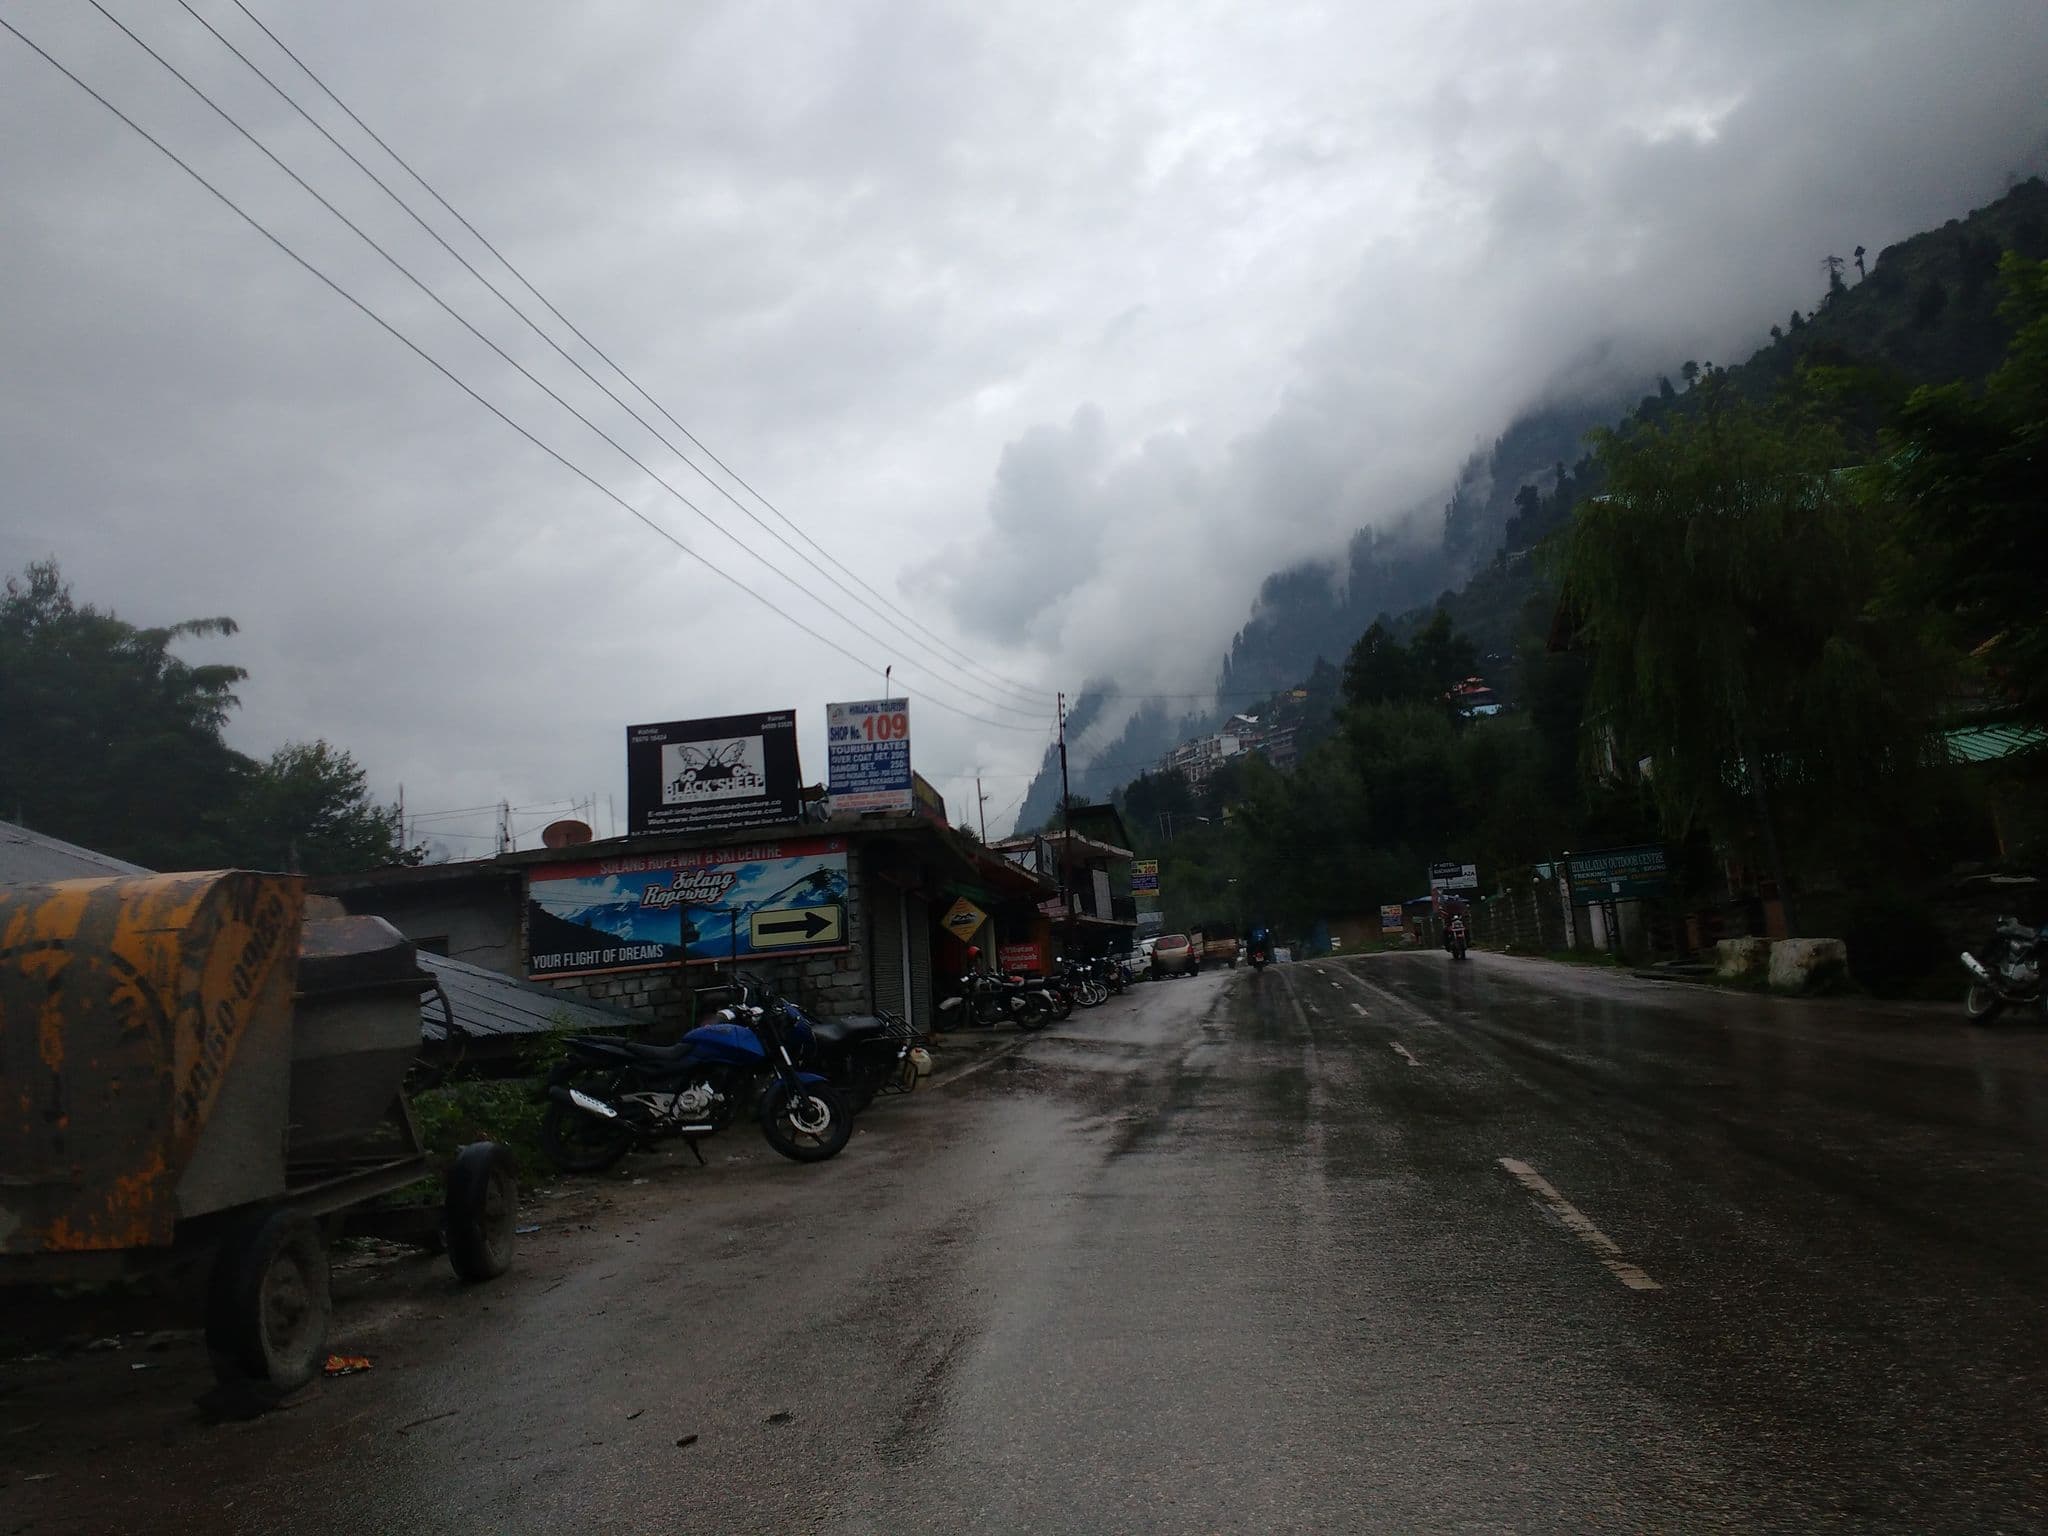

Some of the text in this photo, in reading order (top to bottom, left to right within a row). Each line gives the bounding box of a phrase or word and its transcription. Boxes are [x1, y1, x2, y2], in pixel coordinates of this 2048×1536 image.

[830, 726, 849, 741] SHOP
[863, 713, 907, 741] 109
[831, 740, 907, 755] TOURISM RATES
[853, 753, 873, 762] COAT
[665, 775, 765, 796] BLACK SHEEP
[600, 859, 645, 875] SOLANG
[673, 869, 735, 891] Solang
[643, 884, 722, 906] Ropeway
[532, 944, 664, 969] YOUR FLIGHT OF DREAMS
